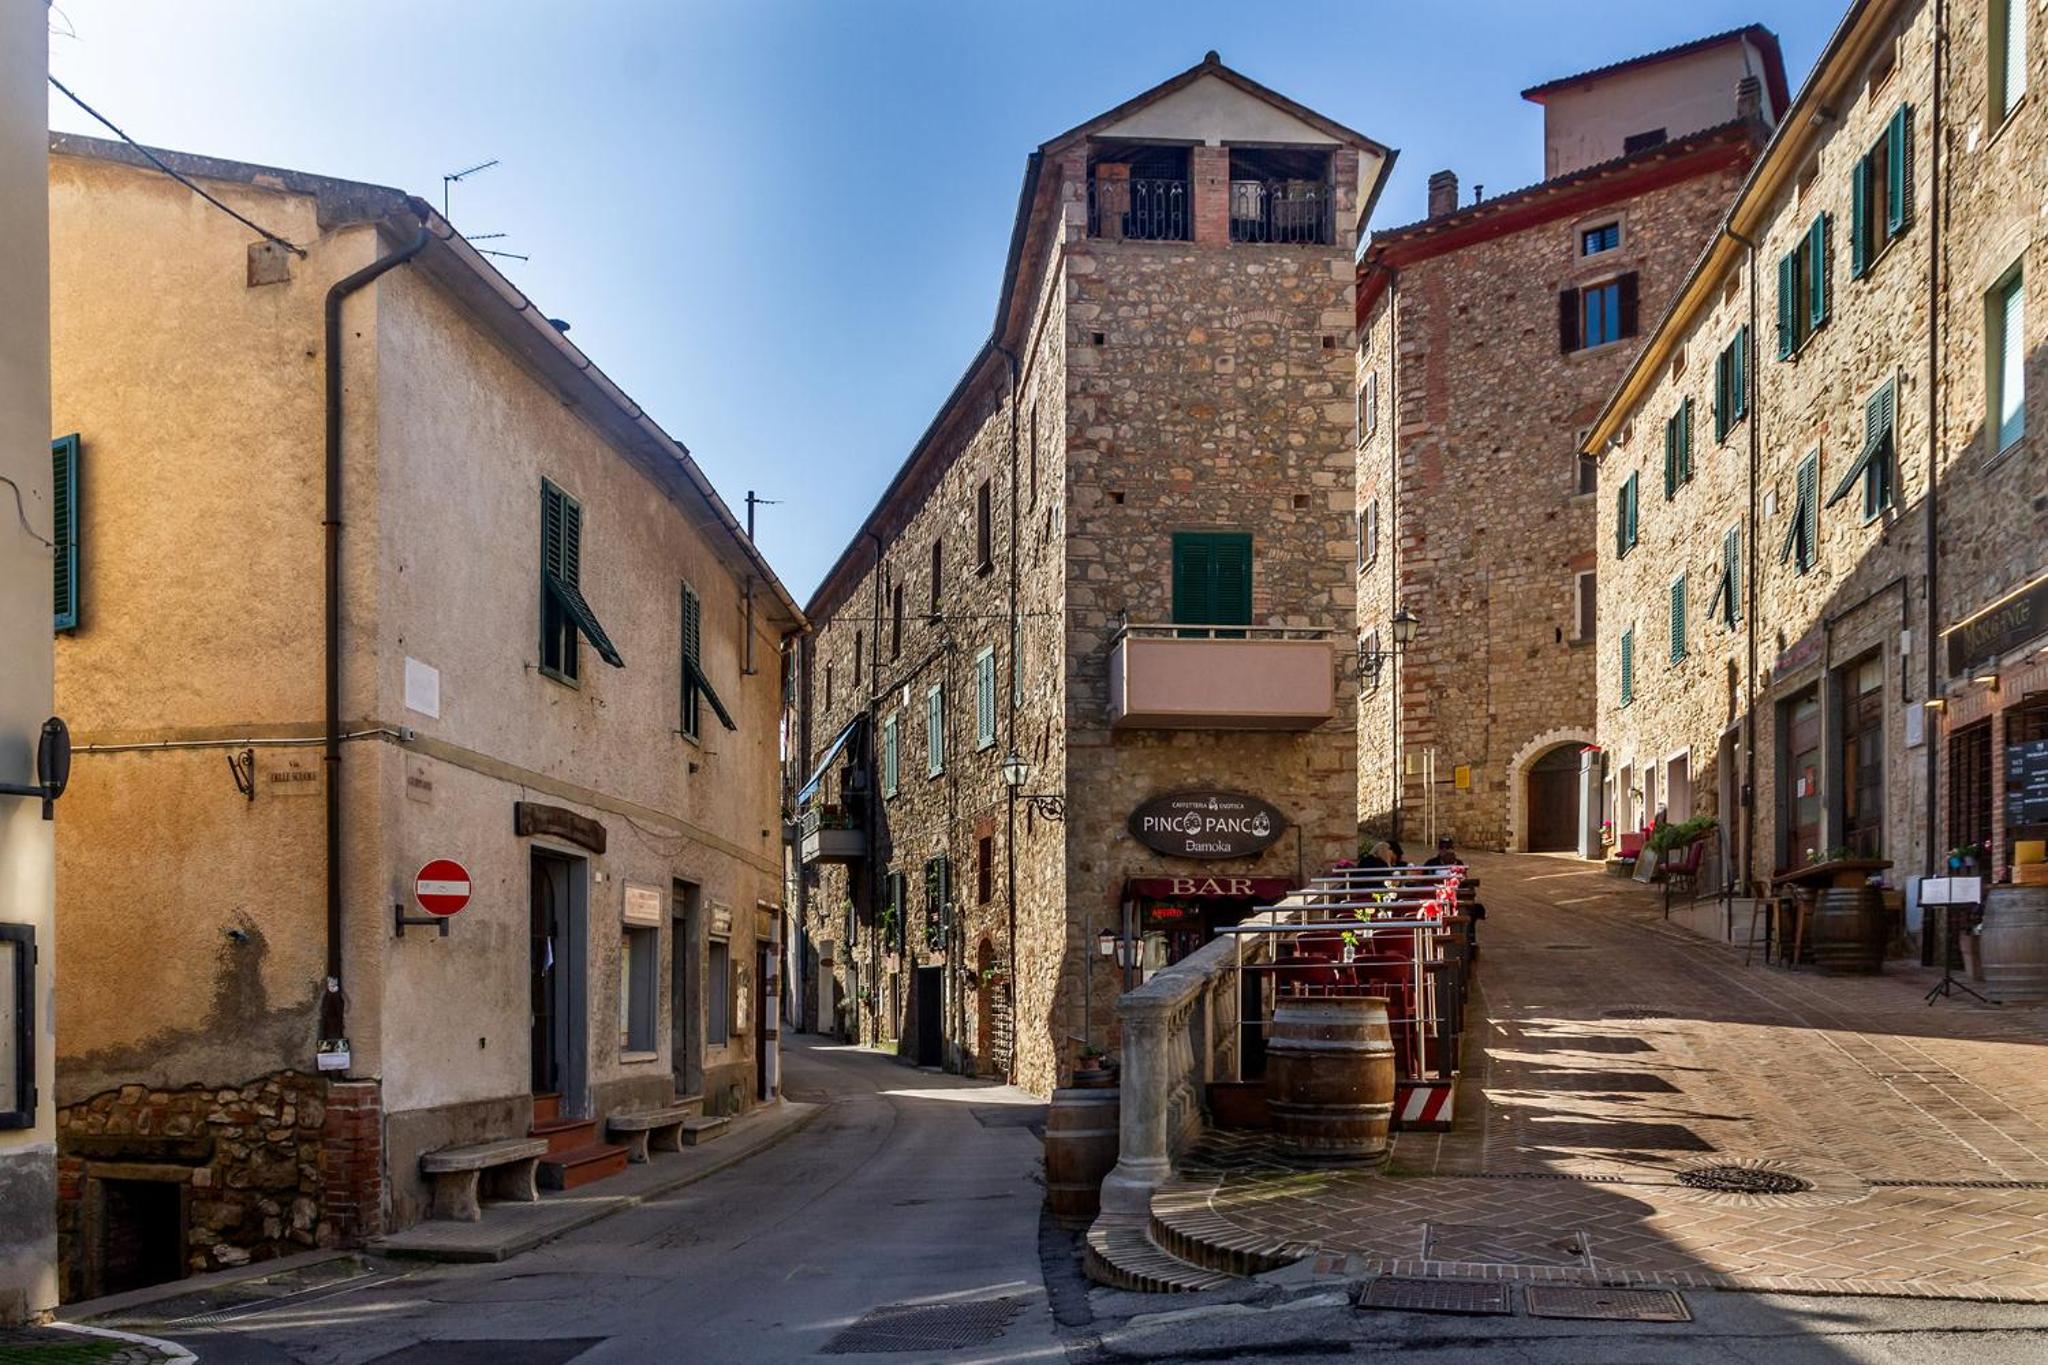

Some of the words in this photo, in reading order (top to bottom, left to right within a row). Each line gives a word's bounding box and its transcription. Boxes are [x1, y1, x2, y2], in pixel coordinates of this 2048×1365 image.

[1143, 811, 1202, 836] PINCO
[1206, 811, 1270, 837] PANCO
[1170, 877, 1256, 895] BAR
